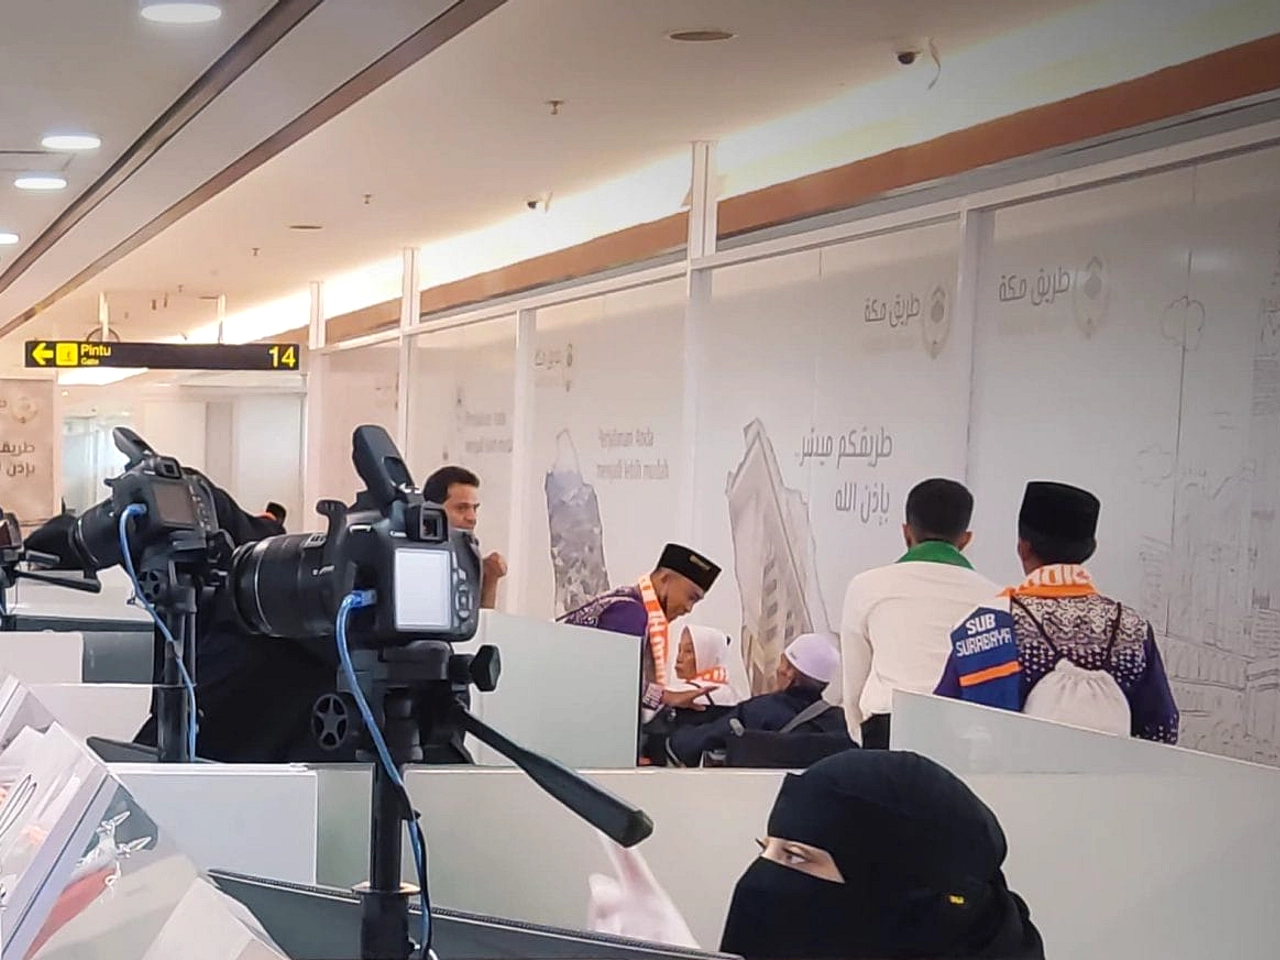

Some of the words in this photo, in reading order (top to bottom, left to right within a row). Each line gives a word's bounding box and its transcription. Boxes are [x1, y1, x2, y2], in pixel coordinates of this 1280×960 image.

[80, 343, 112, 356] Pintu
[268, 345, 296, 368] 14
[965, 612, 997, 636] SUB
[955, 626, 1013, 658] SURABAYA
